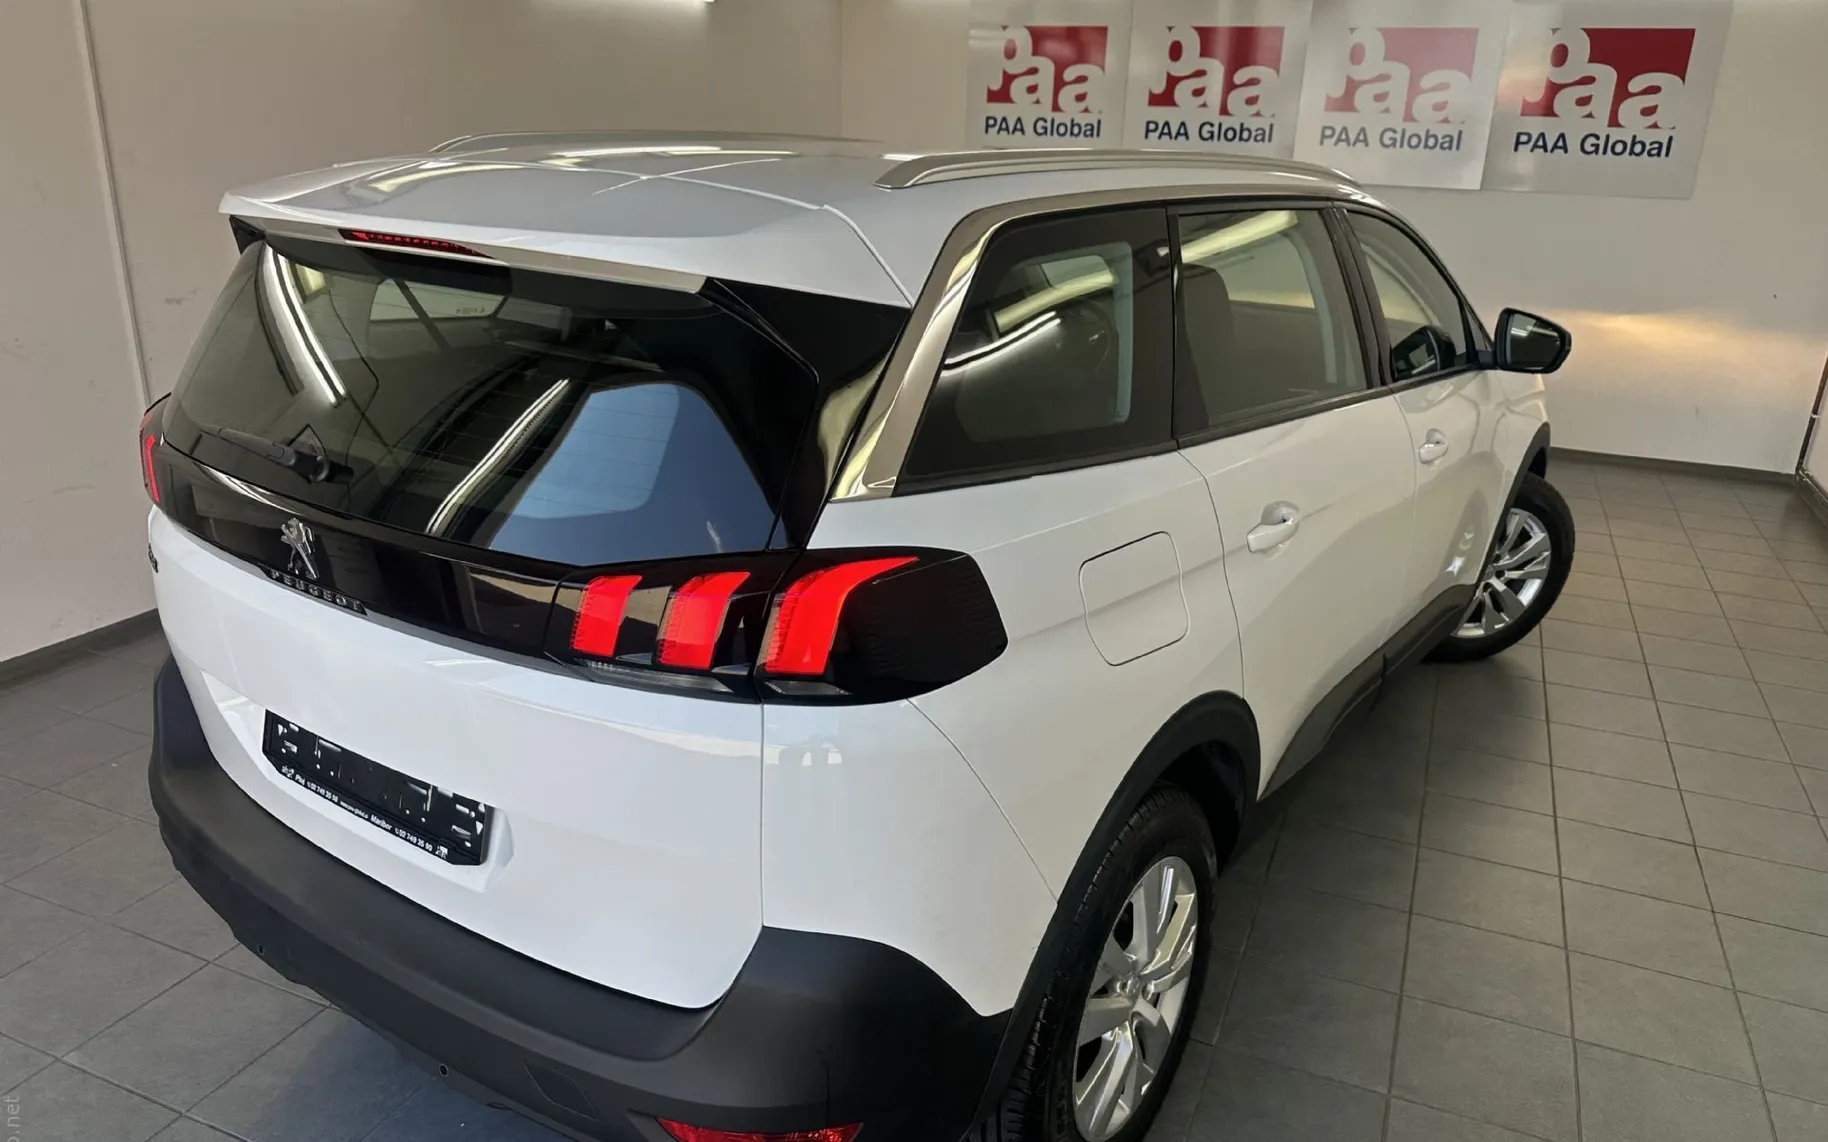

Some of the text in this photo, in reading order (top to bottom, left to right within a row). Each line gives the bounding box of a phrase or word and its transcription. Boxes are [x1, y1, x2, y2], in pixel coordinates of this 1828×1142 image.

[984, 116, 1102, 138] PAA Global
[1144, 120, 1274, 143] PAA Global
[1319, 125, 1463, 151] PAA Global
[1513, 132, 1674, 158] PAA Global
[271, 569, 361, 611] PEUGEOT
[371, 814, 392, 831] Maribor
